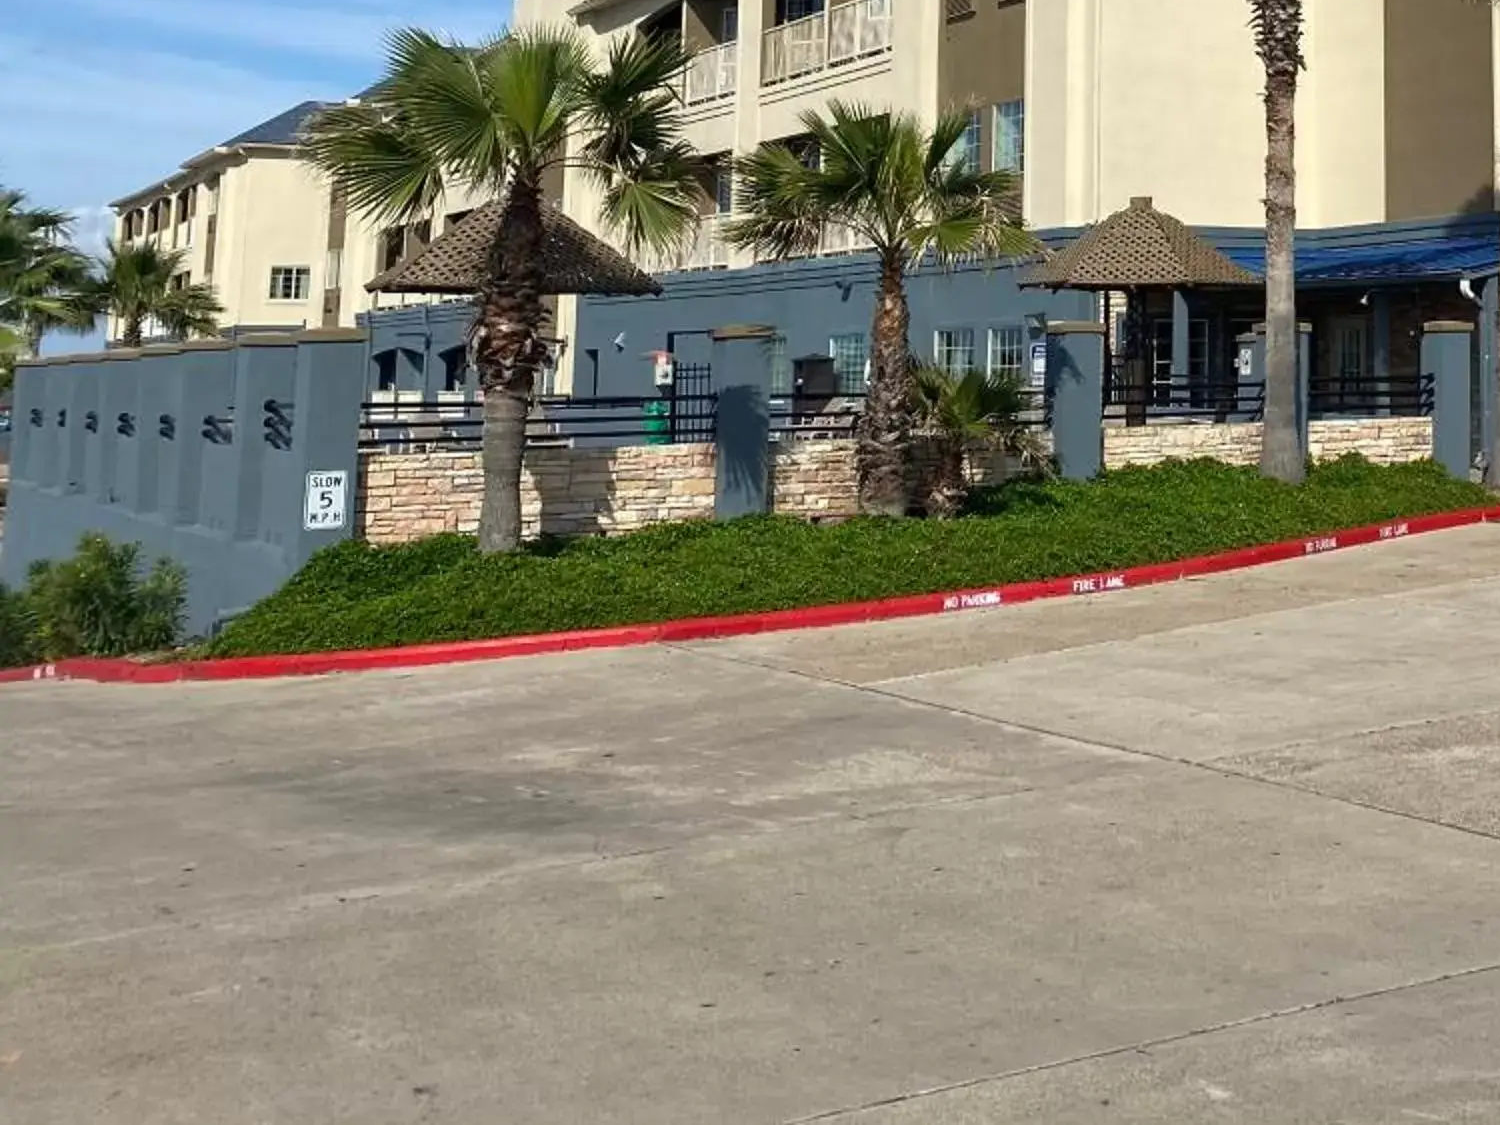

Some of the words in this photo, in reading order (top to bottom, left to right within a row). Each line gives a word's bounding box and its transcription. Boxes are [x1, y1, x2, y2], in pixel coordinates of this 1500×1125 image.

[312, 476, 342, 487] SLOW
[320, 490, 333, 509] 5
[1073, 579, 1096, 592] FIRE
[1100, 575, 1126, 588] LANE
[944, 597, 958, 609] NO
